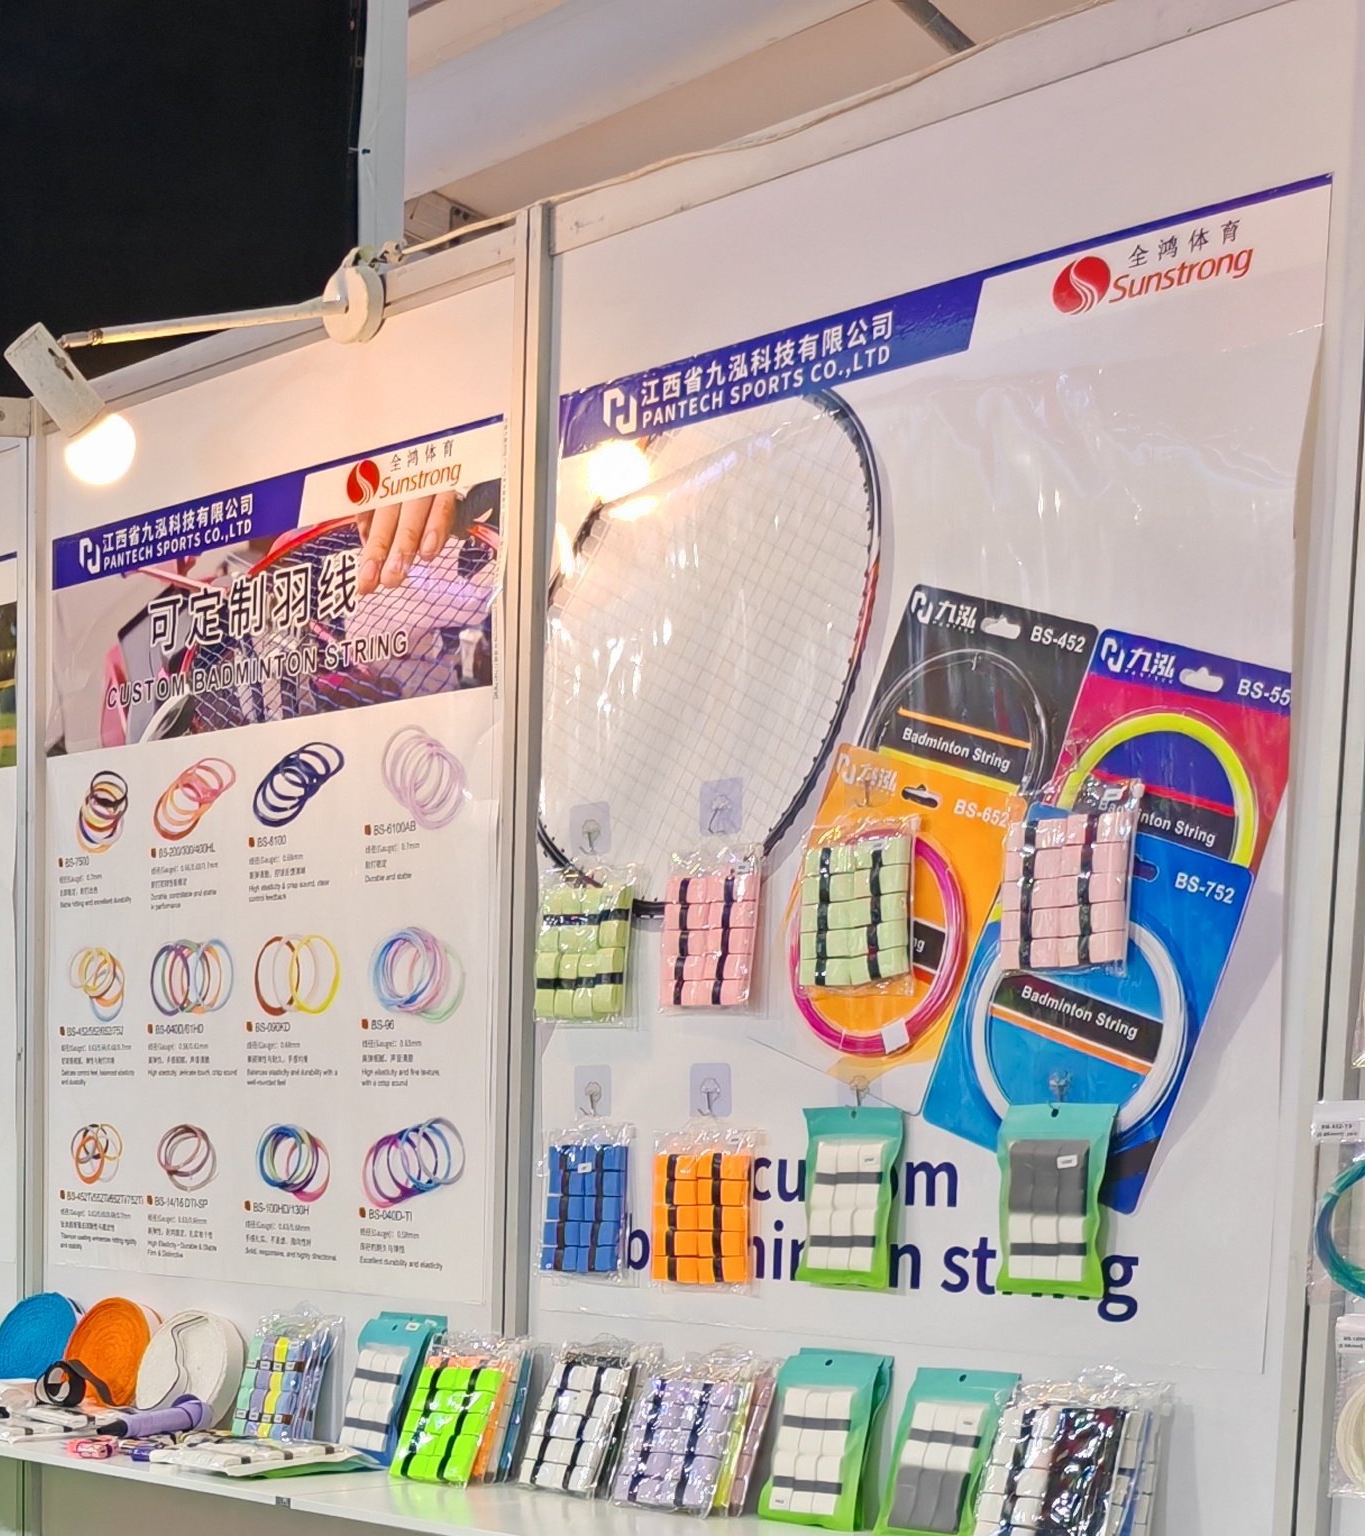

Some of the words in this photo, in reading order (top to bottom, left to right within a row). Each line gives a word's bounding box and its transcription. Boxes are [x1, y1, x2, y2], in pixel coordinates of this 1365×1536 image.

[1128, 218, 1241, 270] 全鸿体育
[1109, 245, 1253, 304] Sunstrong
[641, 310, 893, 407] 江西省九泓科技有限公司
[642, 389, 723, 429] PANTECH
[730, 370, 803, 406] SPORTS
[390, 440, 455, 472] 全鸿体育
[379, 461, 462, 500] Sunstrong
[102, 493, 254, 553] 江西省九泓科技有限公司
[103, 548, 153, 571] PANTECH
[157, 533, 202, 560] SPORTS
[148, 553, 357, 656] 可定制羽线
[934, 600, 977, 630] 九泓
[1030, 625, 1087, 653] BS-452
[106, 671, 187, 710] CUSTOM
[193, 648, 318, 697] BADMINTON
[325, 629, 409, 670] STRING
[1125, 647, 1177, 681] 九泓
[901, 726, 970, 758] Badminton
[972, 746, 1012, 772] String
[953, 798, 1010, 828] BS-652
[1176, 820, 1217, 847] String
[1174, 872, 1236, 905] BS-752
[1021, 984, 1092, 1023] Badminton
[1095, 1009, 1139, 1042] String
